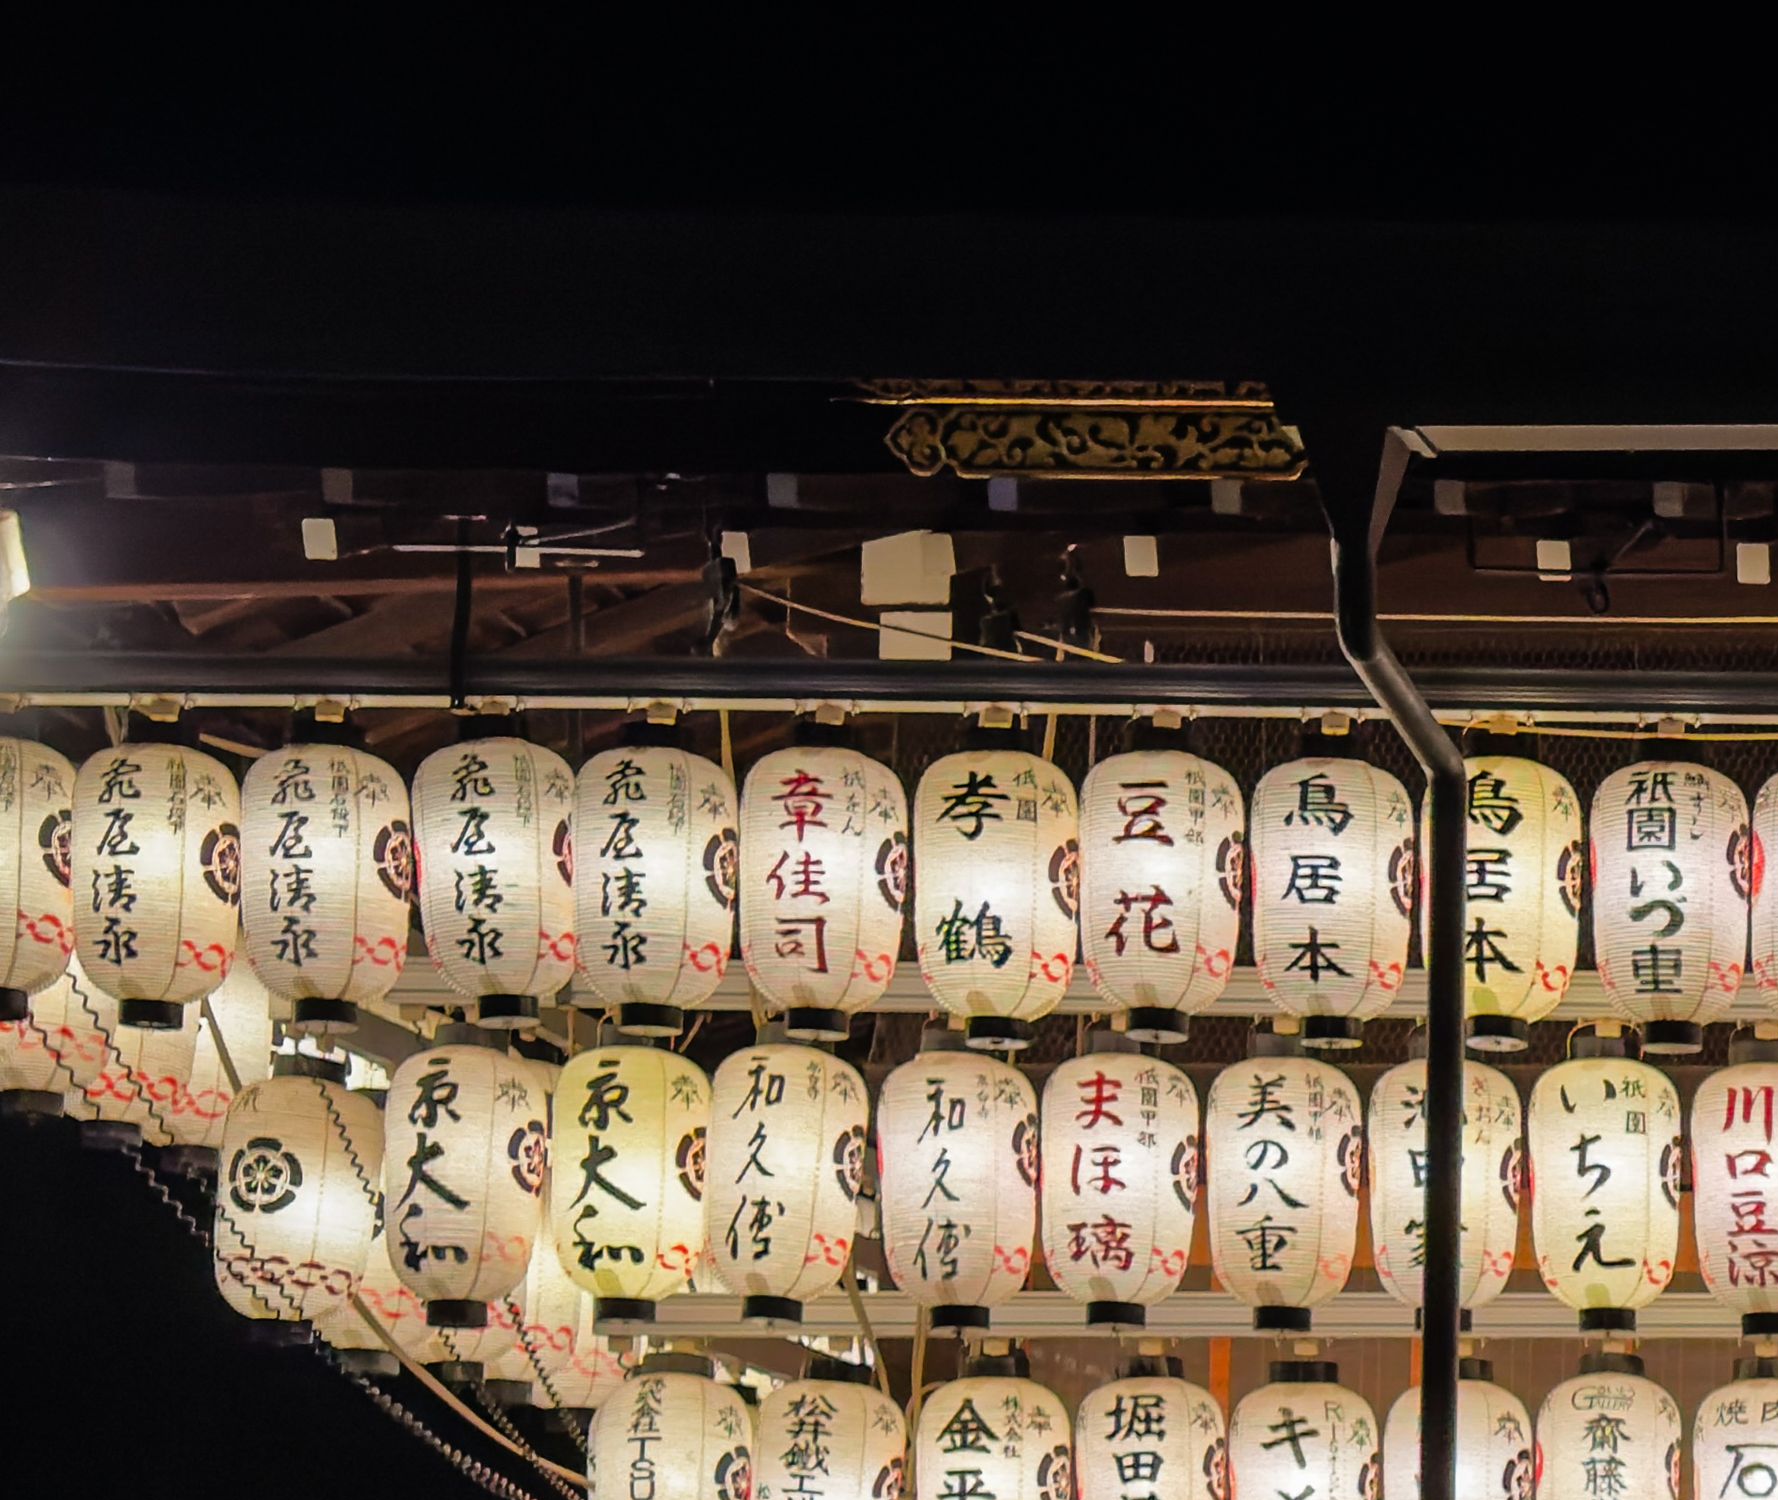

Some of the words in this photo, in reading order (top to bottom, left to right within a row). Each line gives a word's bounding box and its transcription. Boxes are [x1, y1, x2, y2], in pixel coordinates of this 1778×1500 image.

[937, 772, 1012, 967] 孝鶴
[1014, 769, 1038, 821] 祇園
[1106, 782, 1180, 955] 豆花
[1283, 773, 1353, 981] 鳥居本
[1464, 771, 1523, 981] 鳥居本
[1626, 771, 1685, 992] 祇園いづ重
[1236, 1074, 1309, 1272] 美の八重
[1560, 1079, 1637, 1273] いちえ
[1621, 1076, 1646, 1134] 祇園
